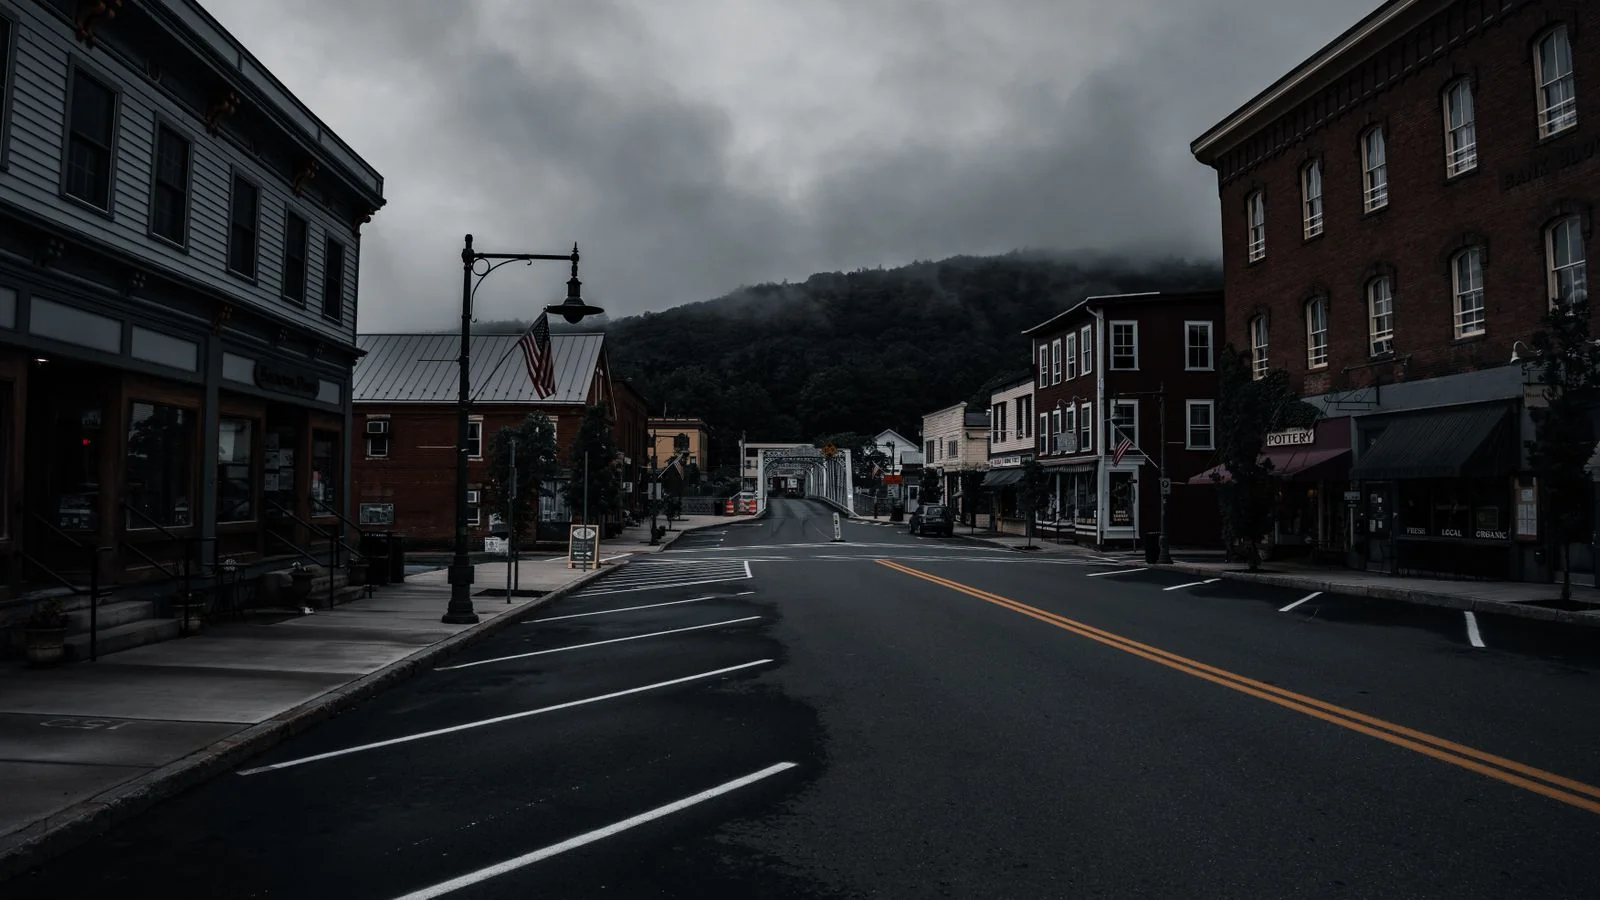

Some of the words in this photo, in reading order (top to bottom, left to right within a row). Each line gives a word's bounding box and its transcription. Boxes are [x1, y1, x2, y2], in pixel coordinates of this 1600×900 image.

[1504, 157, 1550, 190] BANK
[1559, 137, 1600, 169] BLO
[1268, 432, 1313, 445] POTTERY
[1441, 529, 1463, 537] LOCAL
[1475, 530, 1508, 540] ORGANIC
